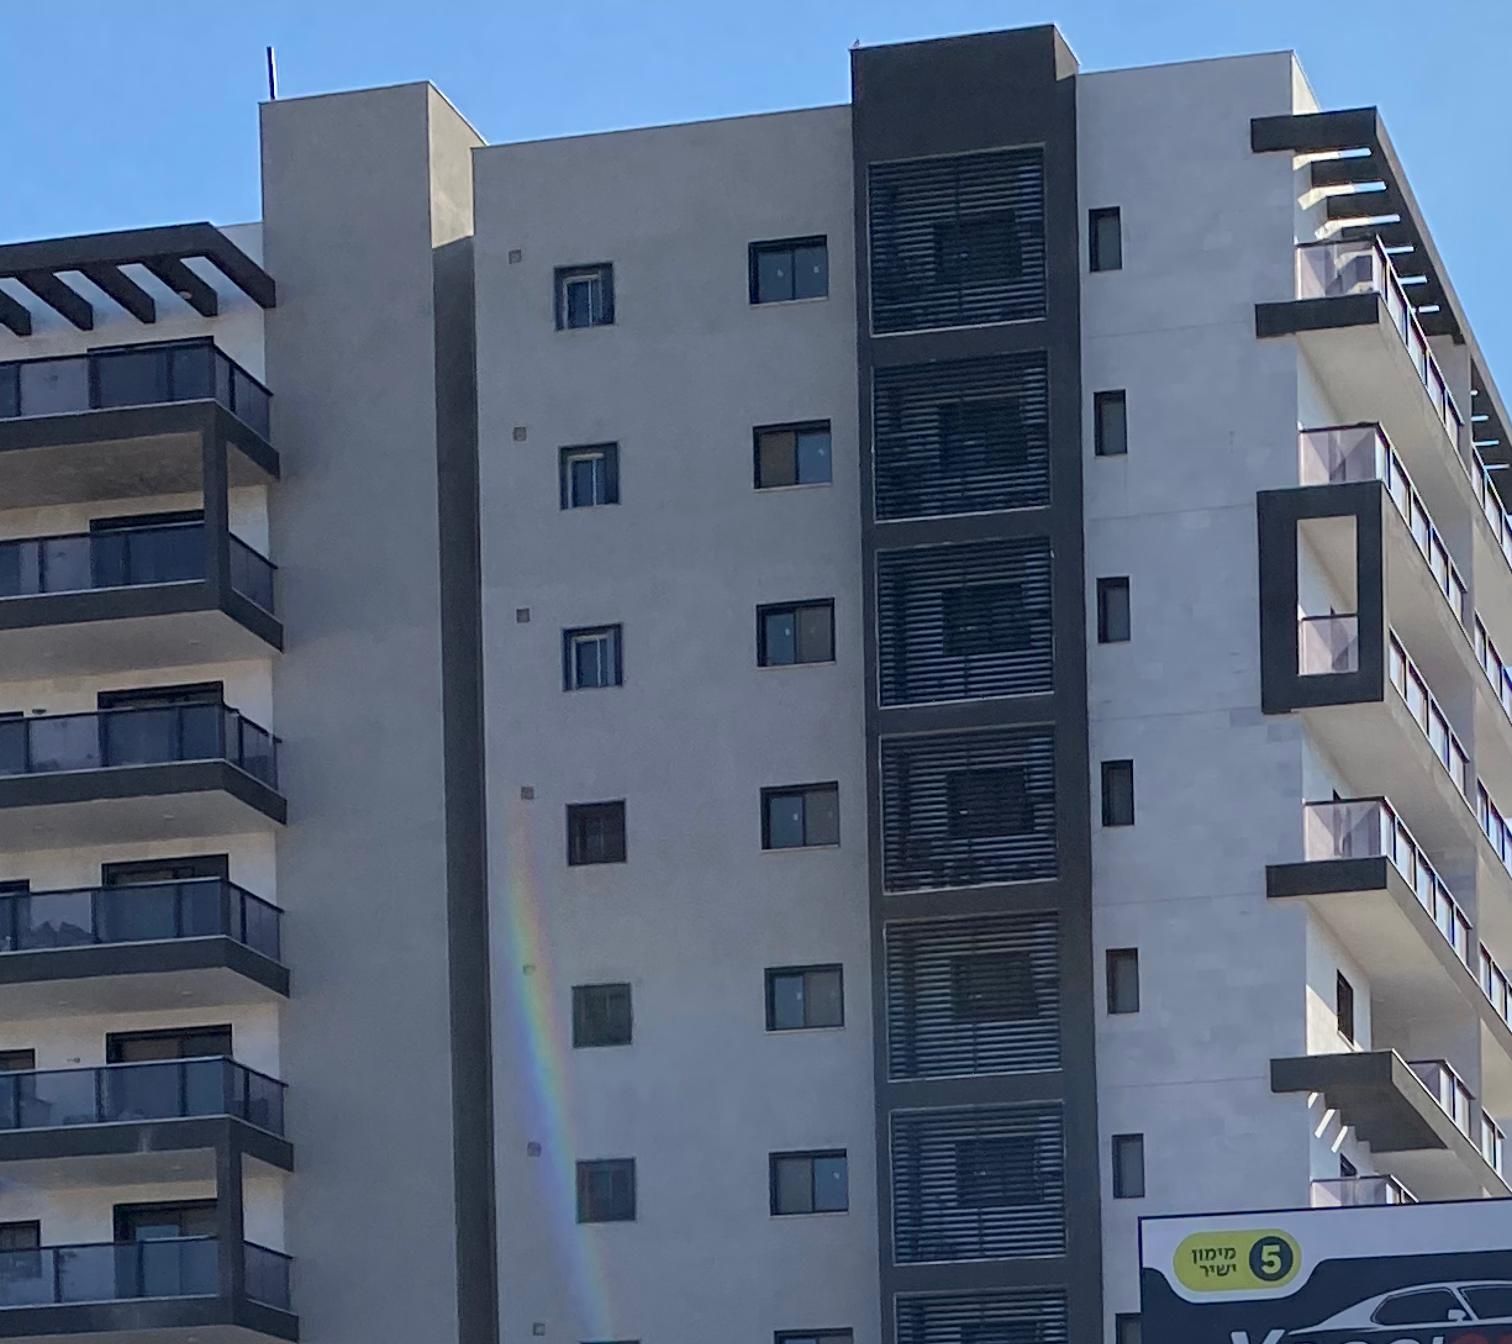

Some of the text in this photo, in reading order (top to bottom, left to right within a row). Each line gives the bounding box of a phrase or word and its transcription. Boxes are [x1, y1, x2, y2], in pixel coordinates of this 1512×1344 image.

[1191, 1247, 1237, 1265] מימון
[1260, 1243, 1282, 1276] 5
[1199, 1263, 1237, 1278] ישיר
